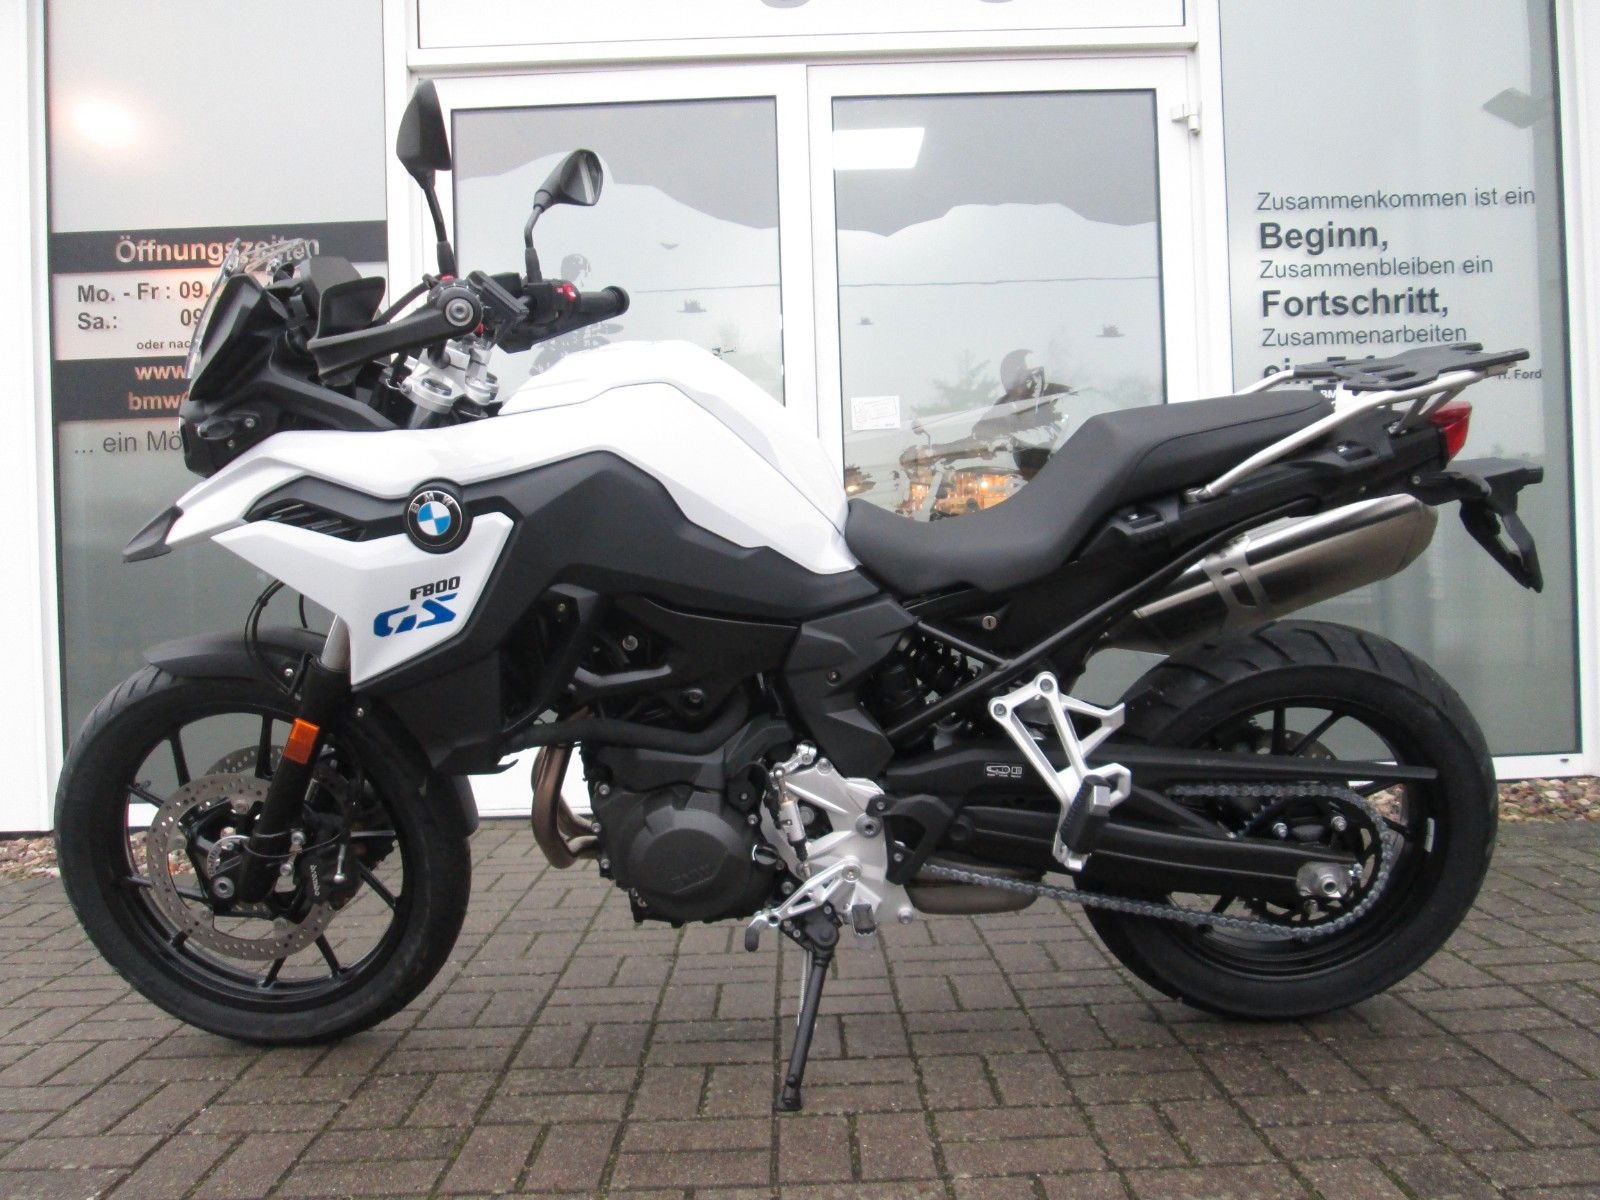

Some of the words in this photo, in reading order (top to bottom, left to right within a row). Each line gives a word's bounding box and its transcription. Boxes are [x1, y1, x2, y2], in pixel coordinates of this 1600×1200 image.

[1257, 189, 1467, 211] Zusammenkommen
[1475, 187, 1498, 206] ist
[1505, 186, 1536, 205] ein
[1260, 221, 1388, 256] Beginn,
[1260, 257, 1455, 279] Zusammenbleiben
[1463, 255, 1493, 274] ein
[77, 284, 116, 303] Mo.
[179, 281, 211, 299] 09.
[1262, 286, 1448, 318] Fortschritt,
[77, 312, 118, 330] Sa.:
[180, 308, 202, 327] 09
[136, 339, 165, 350] oder
[169, 340, 191, 350] nac
[1262, 324, 1467, 347] Zusammenarbeiten
[134, 365, 186, 380] www
[1514, 369, 1542, 379] Ford
[103, 432, 137, 453] ein
[147, 430, 183, 451] Mö
[410, 491, 454, 513] BMW
[410, 576, 461, 600] F800
[373, 592, 458, 637] GS
